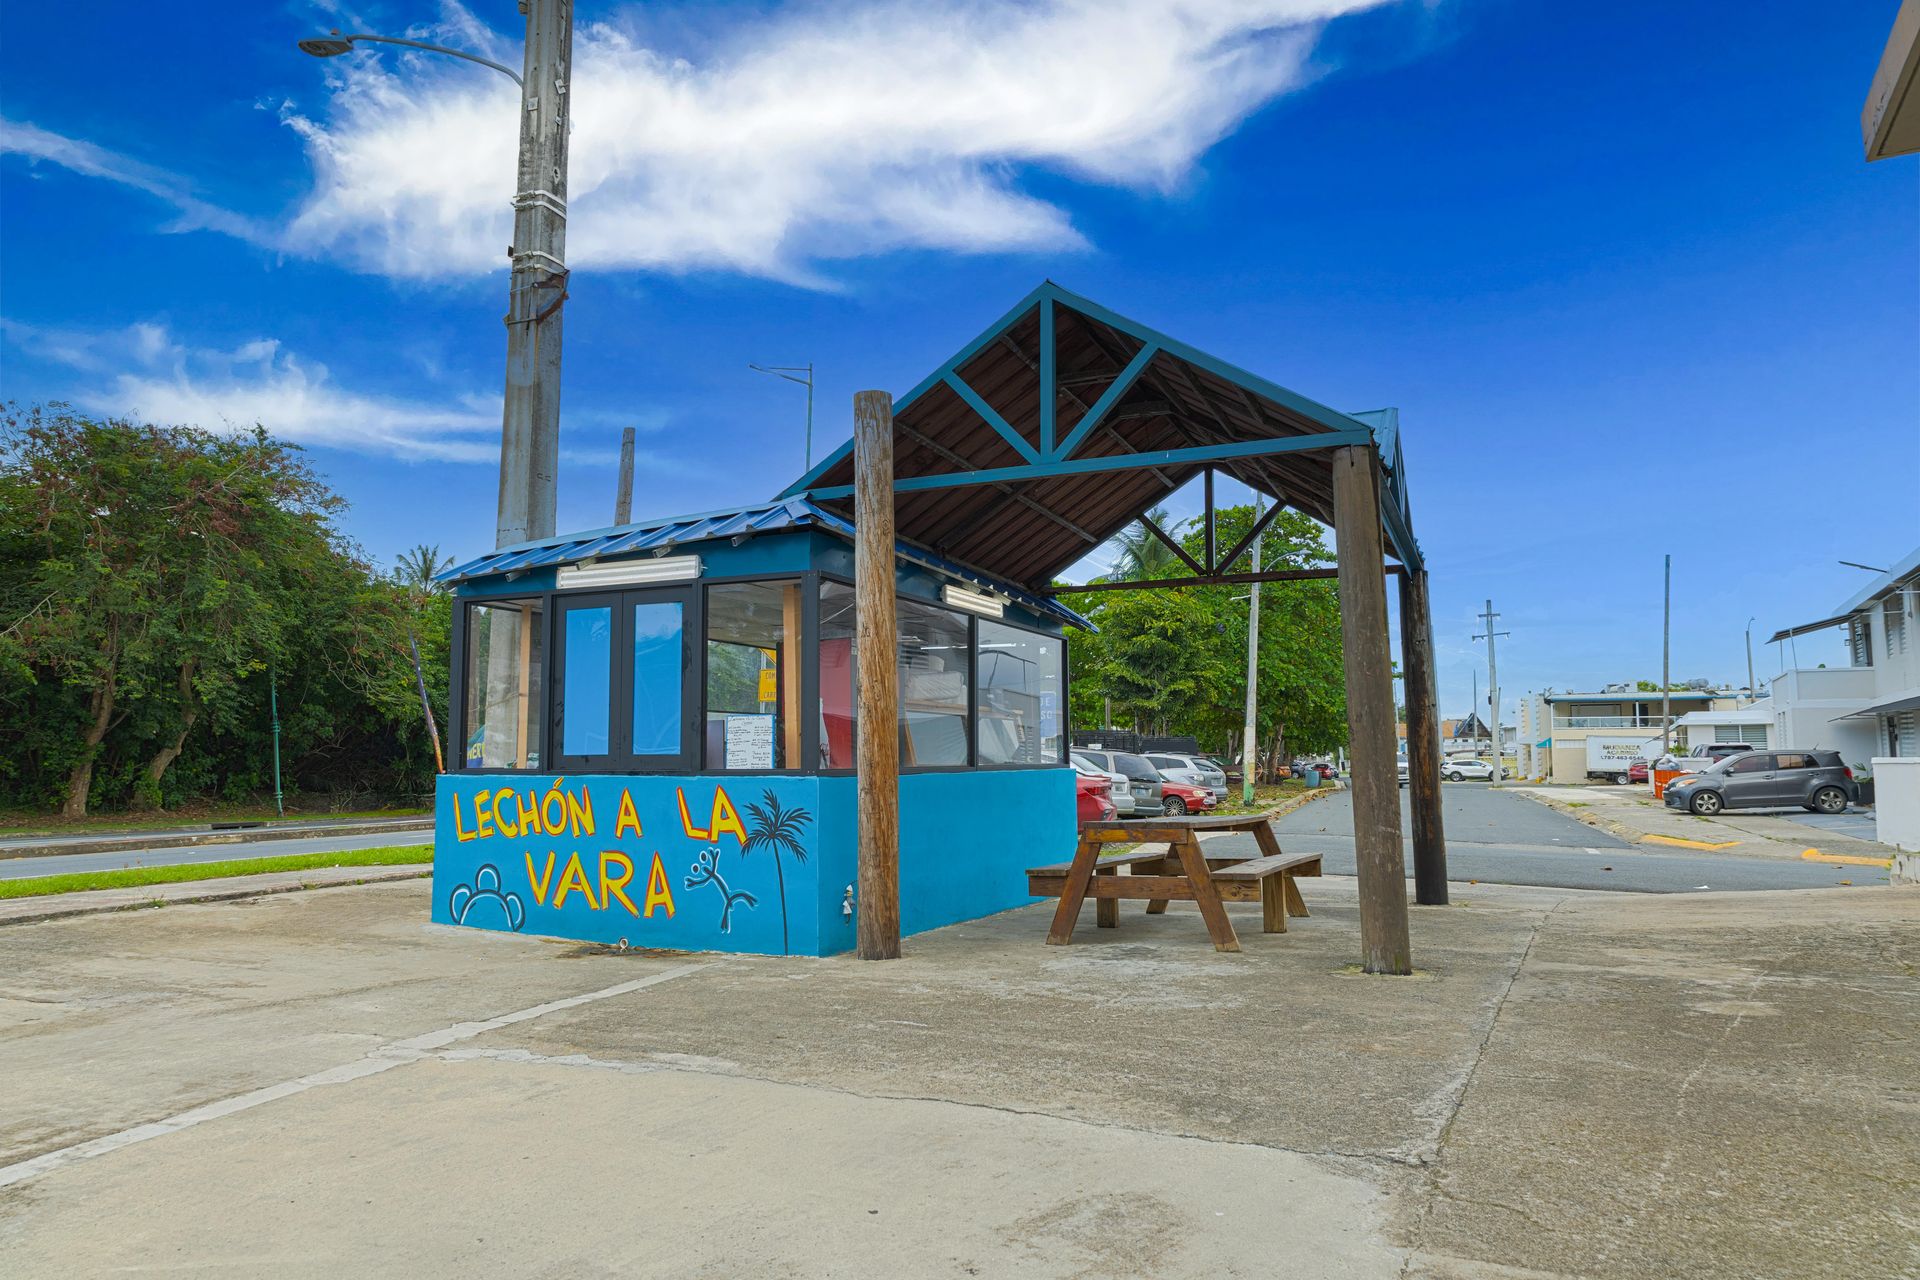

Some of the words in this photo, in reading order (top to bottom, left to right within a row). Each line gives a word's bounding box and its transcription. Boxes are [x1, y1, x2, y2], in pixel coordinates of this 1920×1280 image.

[453, 777, 596, 842] LECHÓN
[615, 787, 643, 839] A
[676, 784, 748, 847] LA
[524, 850, 676, 919] VARA
